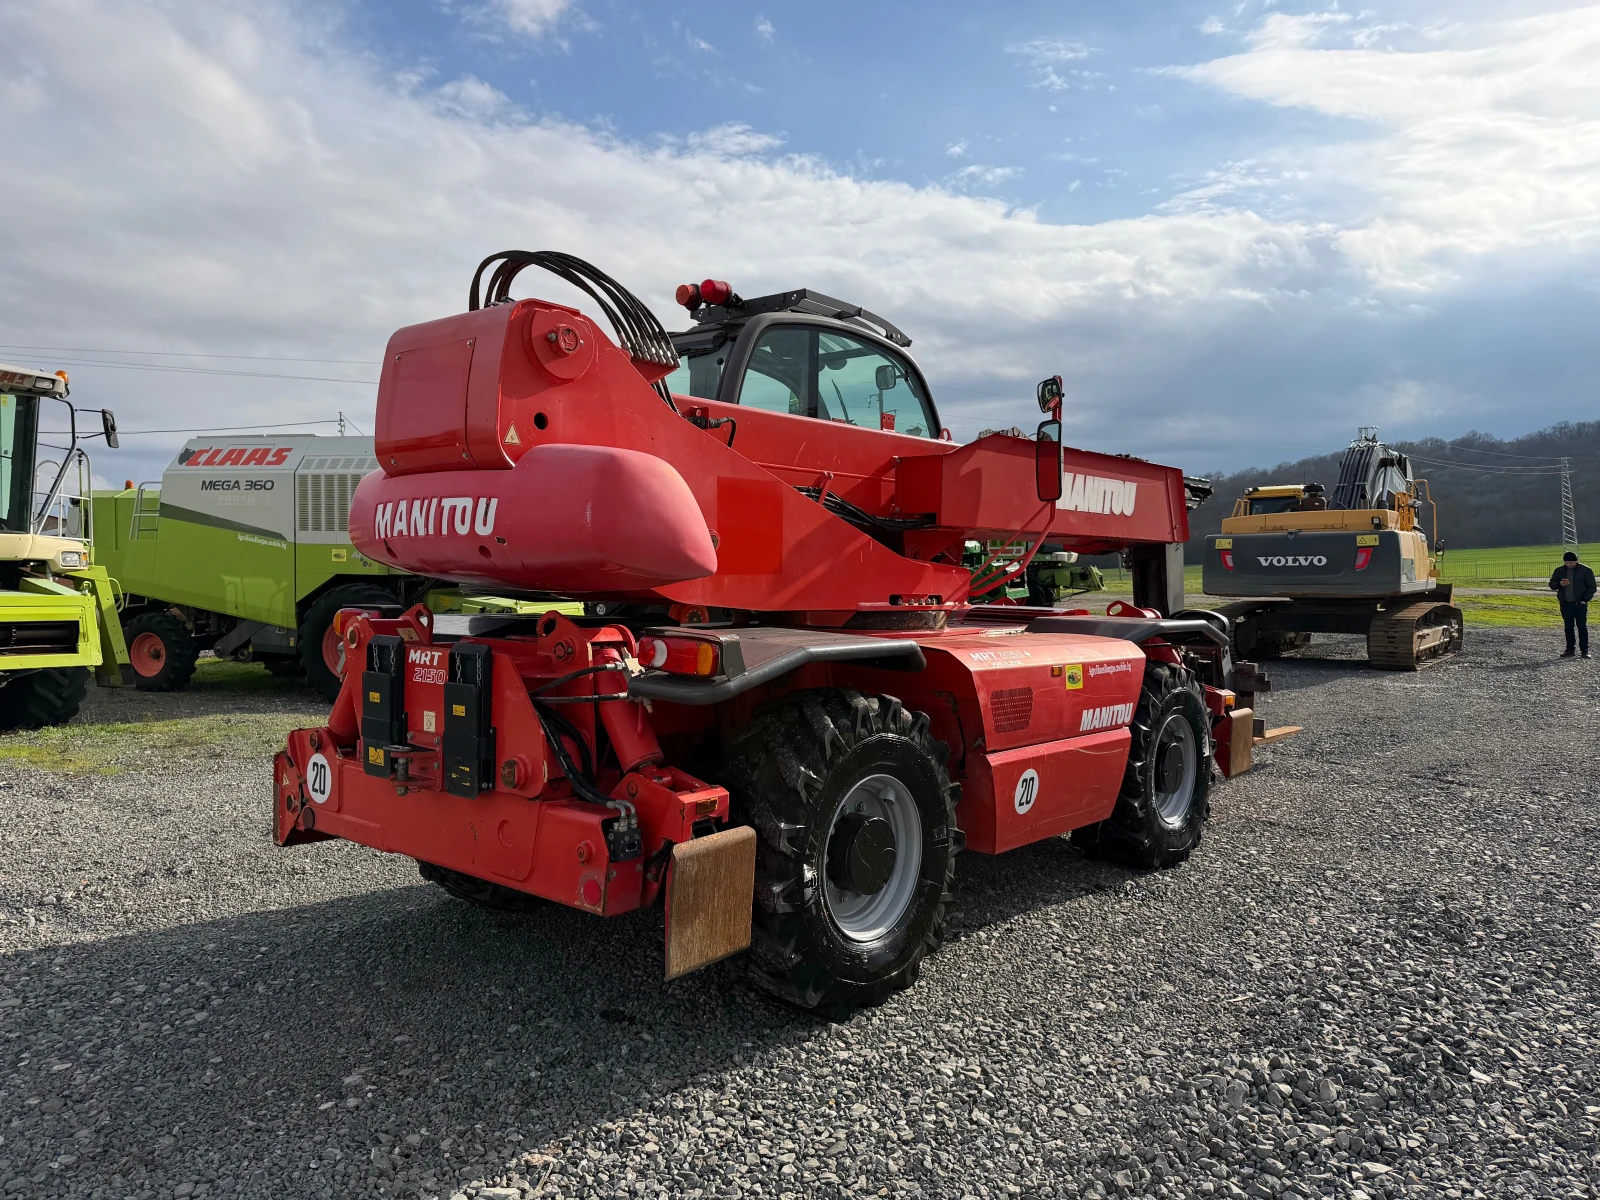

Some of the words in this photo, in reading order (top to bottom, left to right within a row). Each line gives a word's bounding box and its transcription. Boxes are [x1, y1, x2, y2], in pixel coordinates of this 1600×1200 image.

[185, 447, 294, 466] CLAAS
[201, 480, 241, 491] MEGA
[244, 480, 275, 491] 360
[374, 497, 499, 539] MANITOU
[1257, 555, 1327, 567] VOLVO
[597, 605, 605, 613] 20
[408, 649, 442, 666] MRT
[968, 652, 998, 662] MRT
[413, 667, 446, 685] 2150
[1079, 702, 1134, 732] MANITOU
[311, 761, 326, 796] 20
[1018, 776, 1035, 807] 20
